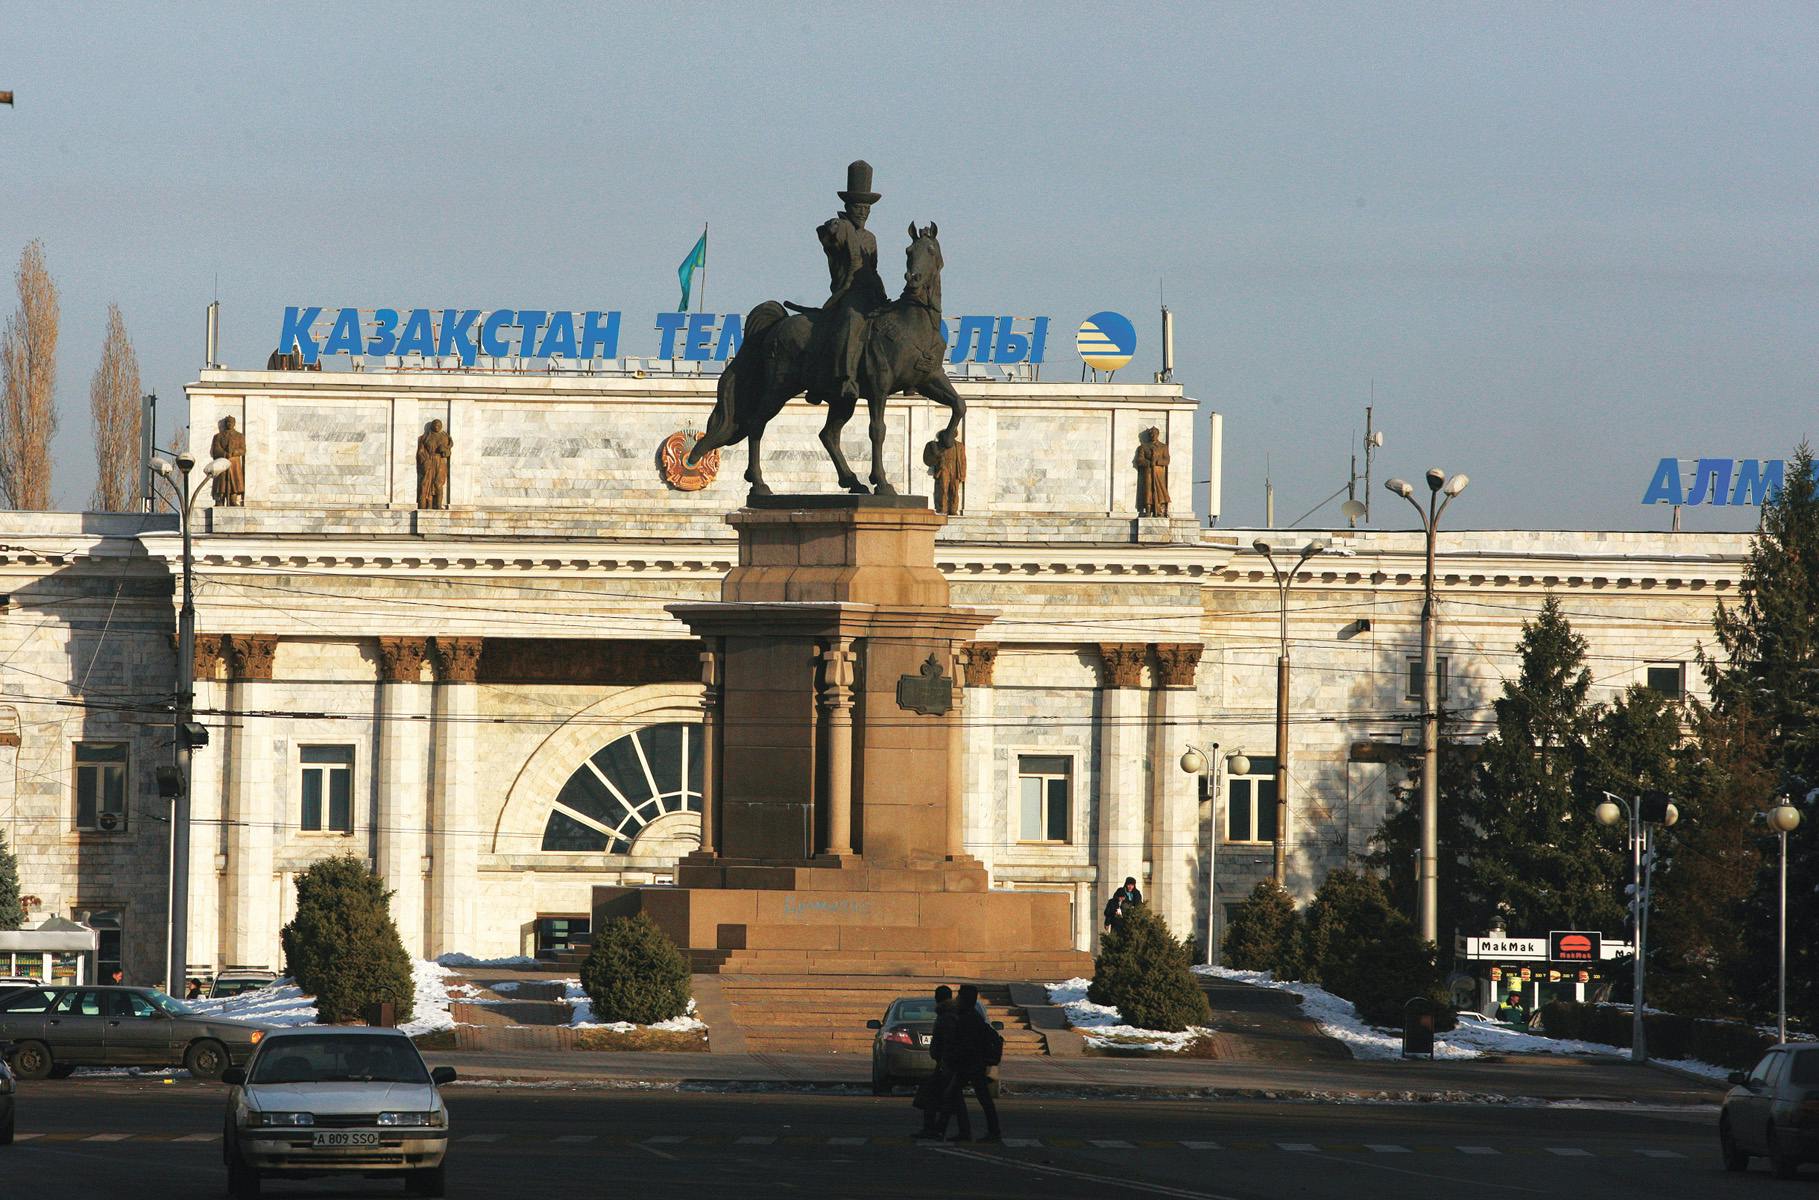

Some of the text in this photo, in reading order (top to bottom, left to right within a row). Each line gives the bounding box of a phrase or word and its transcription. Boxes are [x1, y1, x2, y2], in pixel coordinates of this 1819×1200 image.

[277, 306, 622, 367] ҚАЗАҚСТАН
[1641, 458, 1819, 507] АЛМ
[1481, 941, 1535, 952] MakMak
[317, 1133, 326, 1145] A
[328, 1133, 349, 1145] 809
